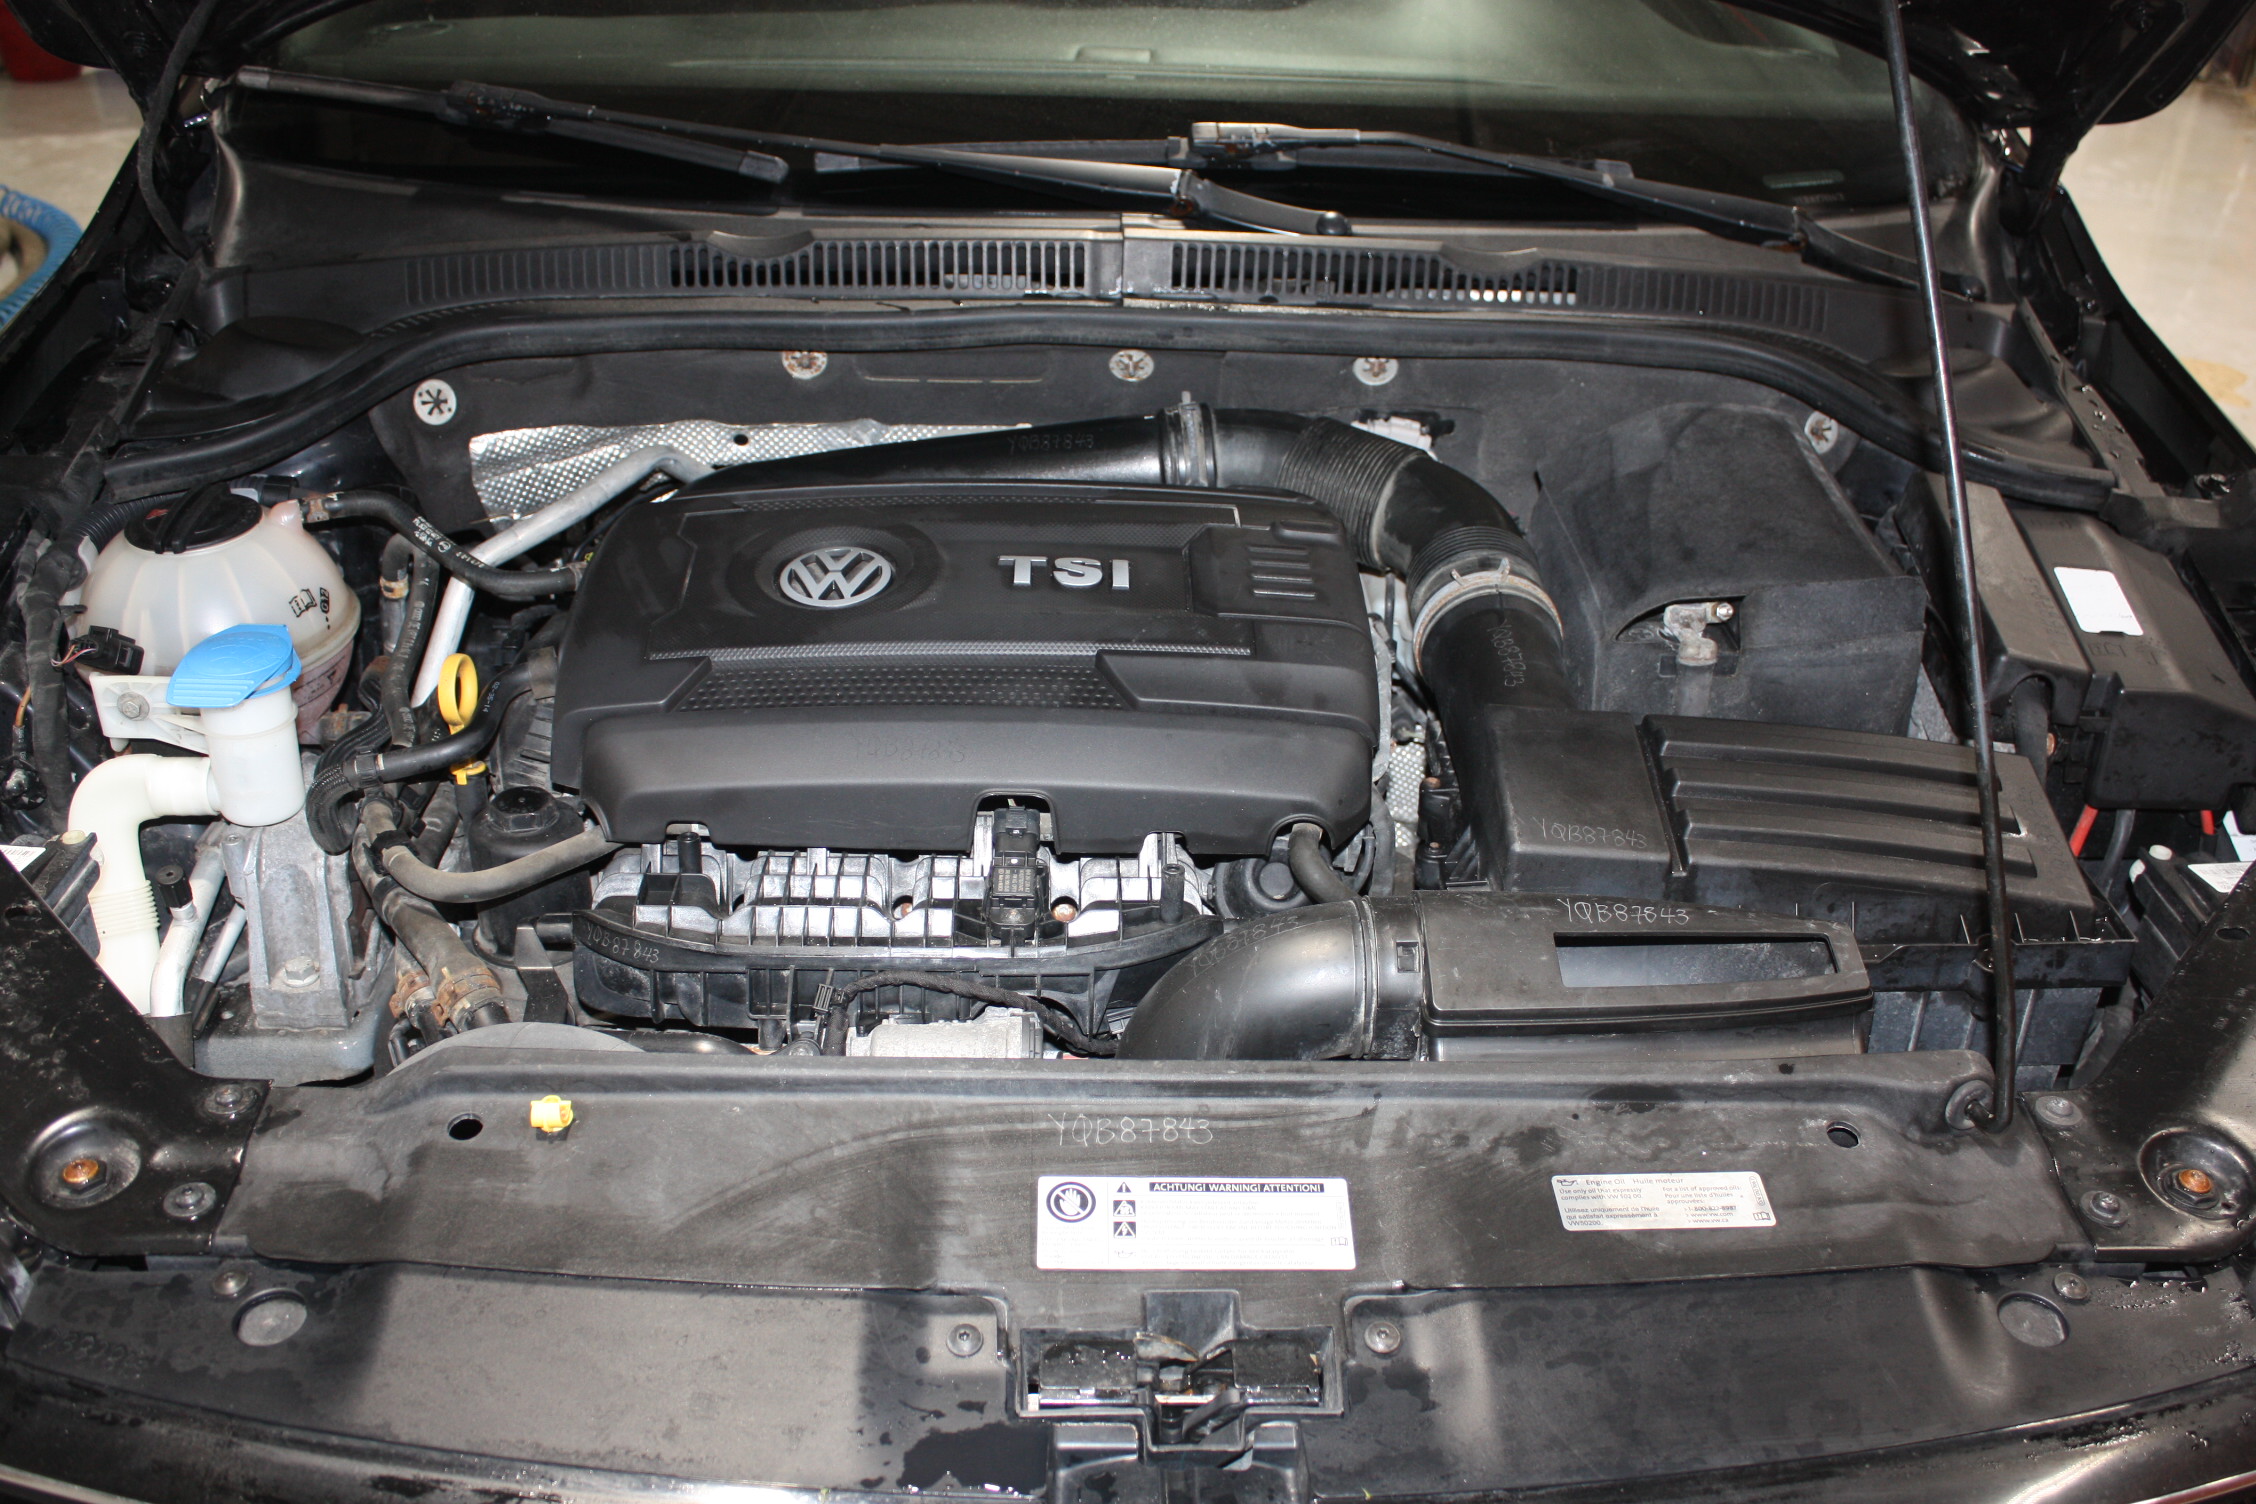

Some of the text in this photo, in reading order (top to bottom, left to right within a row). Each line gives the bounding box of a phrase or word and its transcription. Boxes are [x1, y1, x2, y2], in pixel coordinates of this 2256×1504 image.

[998, 555, 1130, 590] TSI
[1486, 618, 1527, 687] YQB87843
[1531, 816, 1648, 848] YQB87843
[1556, 897, 1690, 925] YQB87843
[587, 922, 660, 964] YQB87843
[1047, 1112, 1214, 1147] YQB87843
[1153, 1183, 1321, 1193] ACHTUNG! WARNING! ATTENTION!
